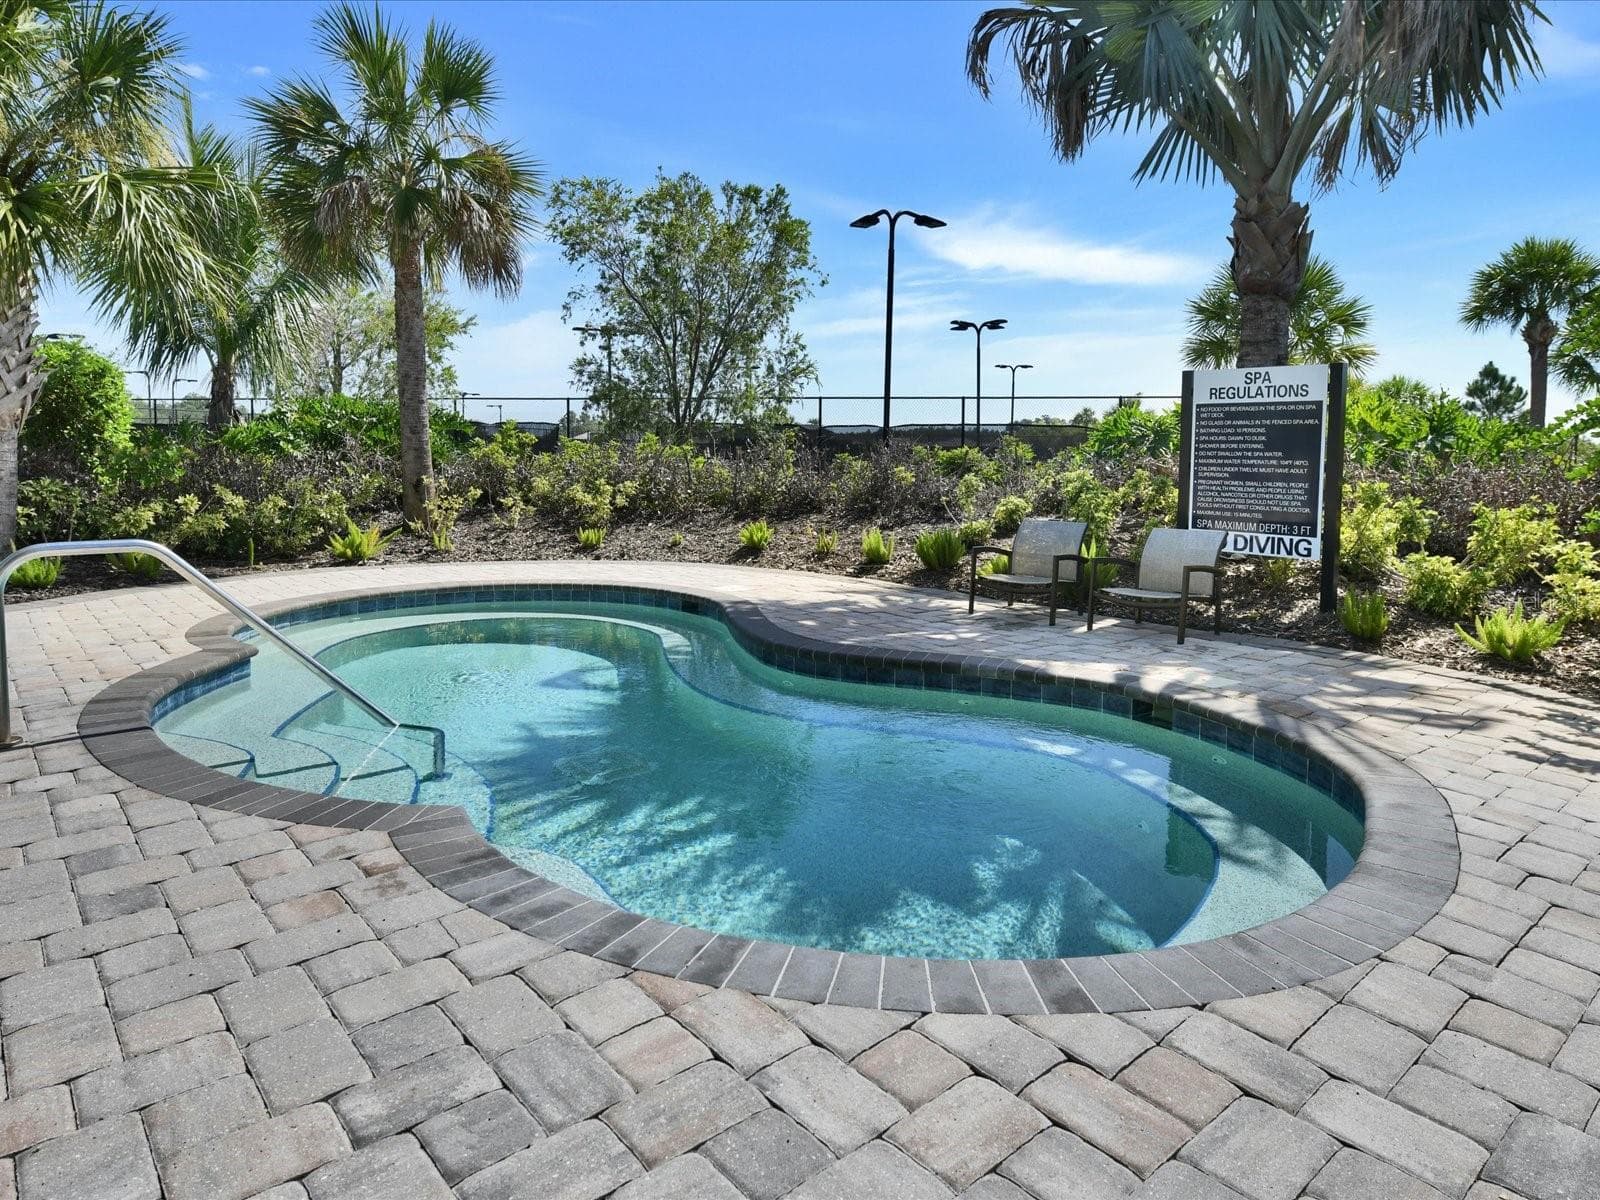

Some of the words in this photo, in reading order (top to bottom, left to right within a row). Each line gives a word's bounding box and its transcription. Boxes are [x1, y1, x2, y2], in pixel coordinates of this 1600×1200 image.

[1244, 371, 1272, 384] SPA
[1209, 384, 1309, 400] REGULATIONS
[1196, 519, 1213, 528] SPA
[1215, 520, 1256, 532] MAXIMUM
[1260, 524, 1290, 534] DEPTH:
[1293, 525, 1298, 534] 3
[1301, 526, 1311, 535] FT
[1233, 534, 1312, 557] DIVING
